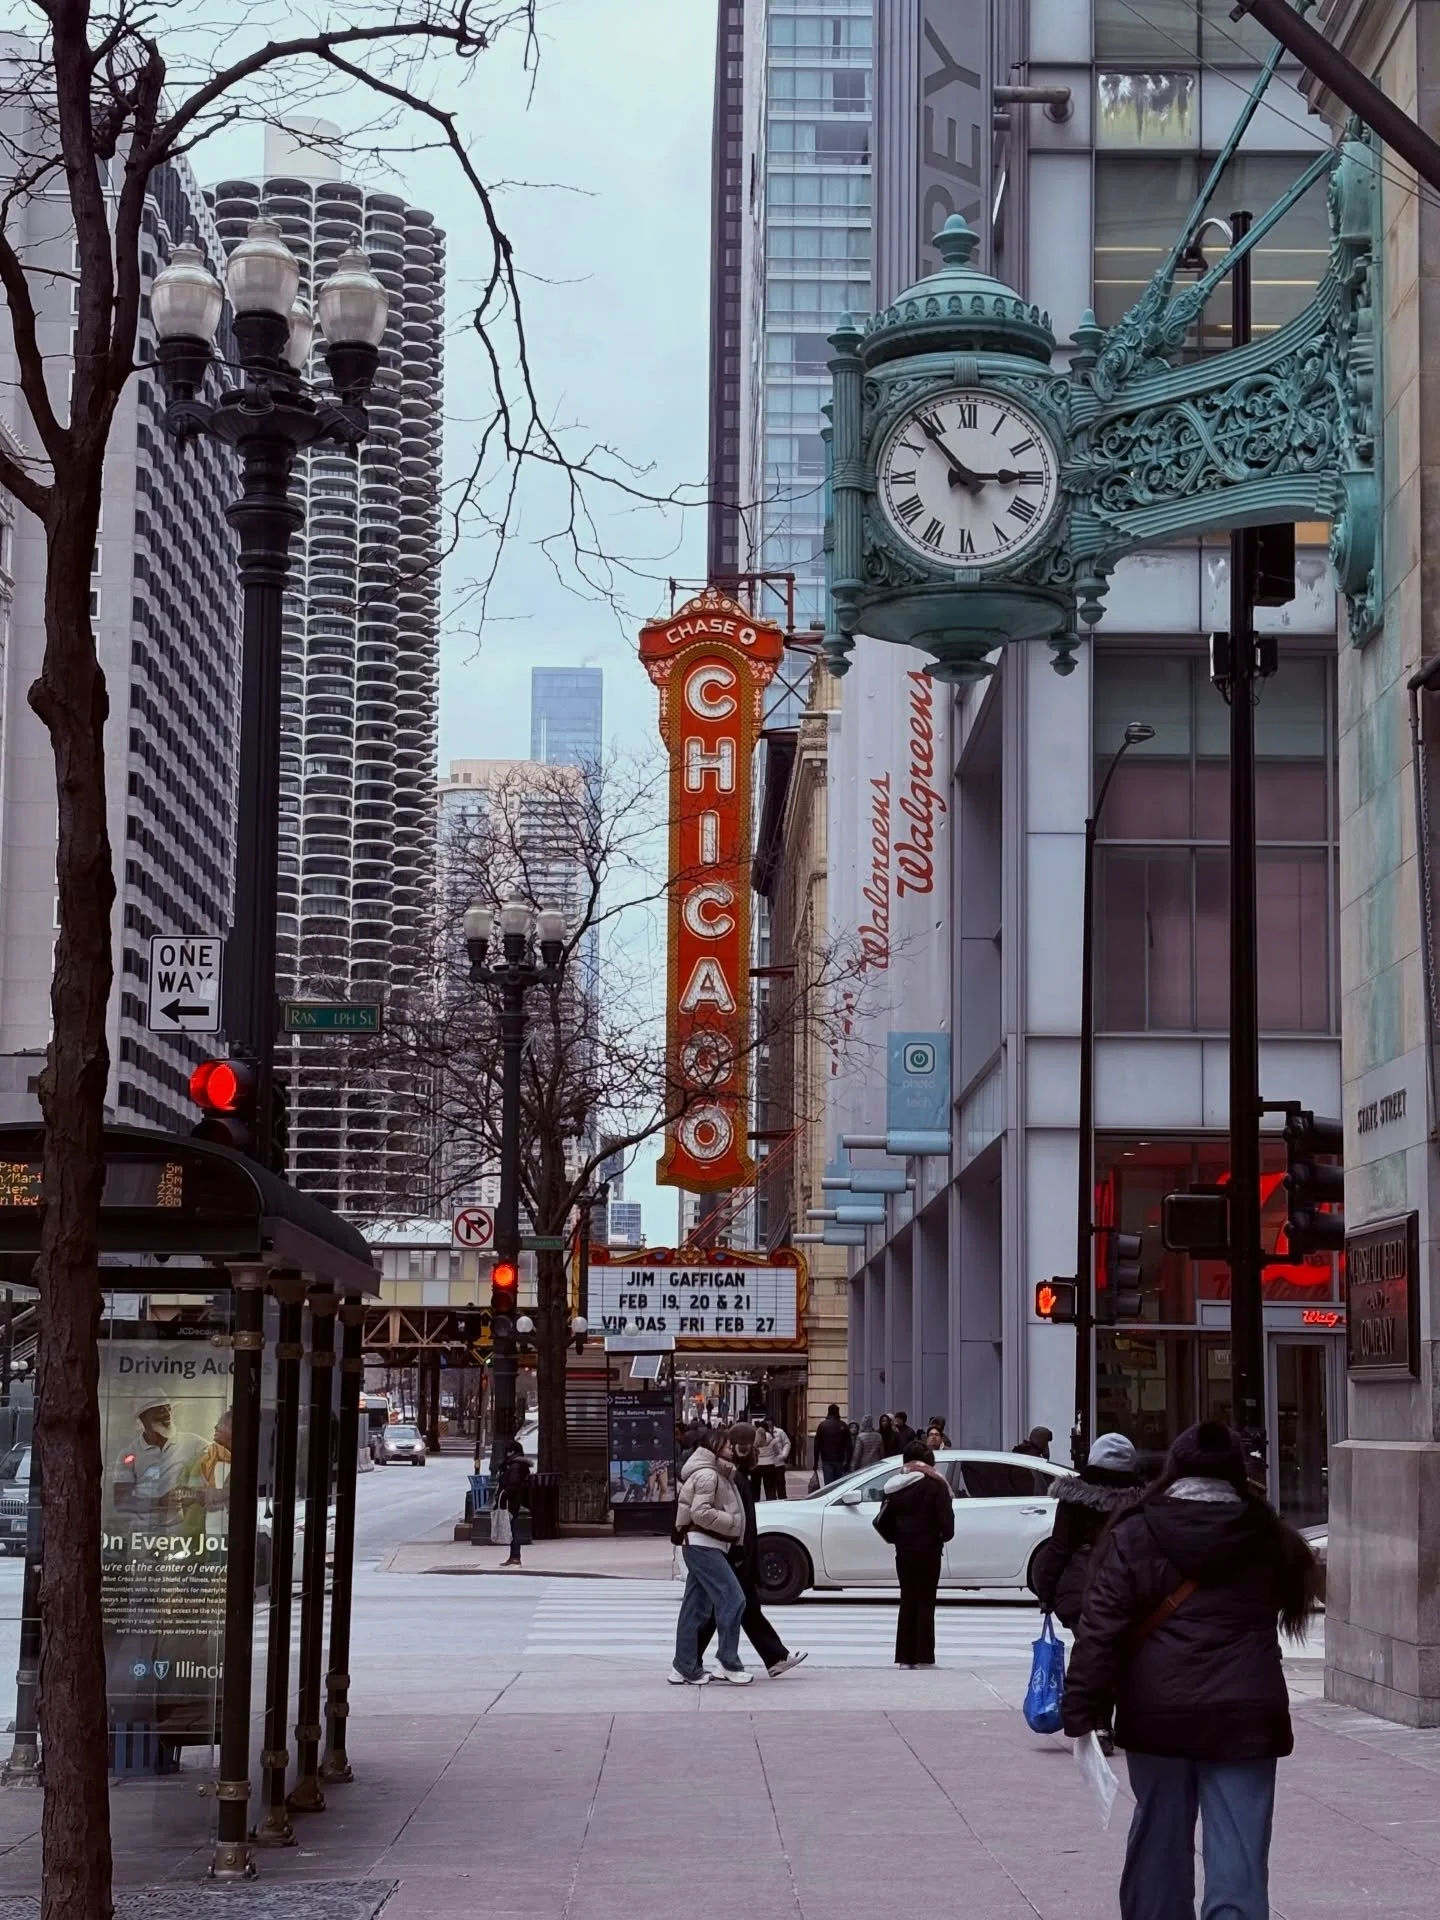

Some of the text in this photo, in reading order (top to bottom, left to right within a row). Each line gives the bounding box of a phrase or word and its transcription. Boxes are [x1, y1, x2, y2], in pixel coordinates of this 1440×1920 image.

[958, 404, 978, 429] XII
[991, 413, 1007, 436] I
[899, 436, 926, 459] X
[1009, 438, 1036, 459] II
[890, 470, 917, 485] IX
[921, 517, 945, 548] VII
[958, 528, 975, 554] VI
[992, 522, 1011, 546] V
[666, 617, 735, 644] CHASE
[894, 670, 947, 898] Walgreens
[679, 664, 738, 1165] CHICAGO
[160, 945, 213, 966] ONE
[291, 1009, 356, 1025] RANLPH
[1357, 1087, 1407, 1136] STATE STREET
[161, 1174, 183, 1184] 15m
[166, 1163, 183, 1173] 5m
[157, 1185, 182, 1195] 22m
[157, 1195, 182, 1206] 28m
[1383, 1239, 1405, 1281] FIELD
[626, 1272, 745, 1287] JIM GAFFIGAN
[619, 1294, 750, 1310] FEB 19, 20 & 21
[601, 1316, 774, 1331] VIR DAS FRI FEB 27
[1359, 1317, 1395, 1357] COMPANY
[119, 1356, 196, 1379] Driving
[131, 1532, 193, 1555] Every
[102, 1562, 122, 1572] u're
[137, 1561, 152, 1572] the
[155, 1563, 184, 1572] center
[187, 1562, 198, 1575] of
[175, 1662, 224, 1679] Illinoi
